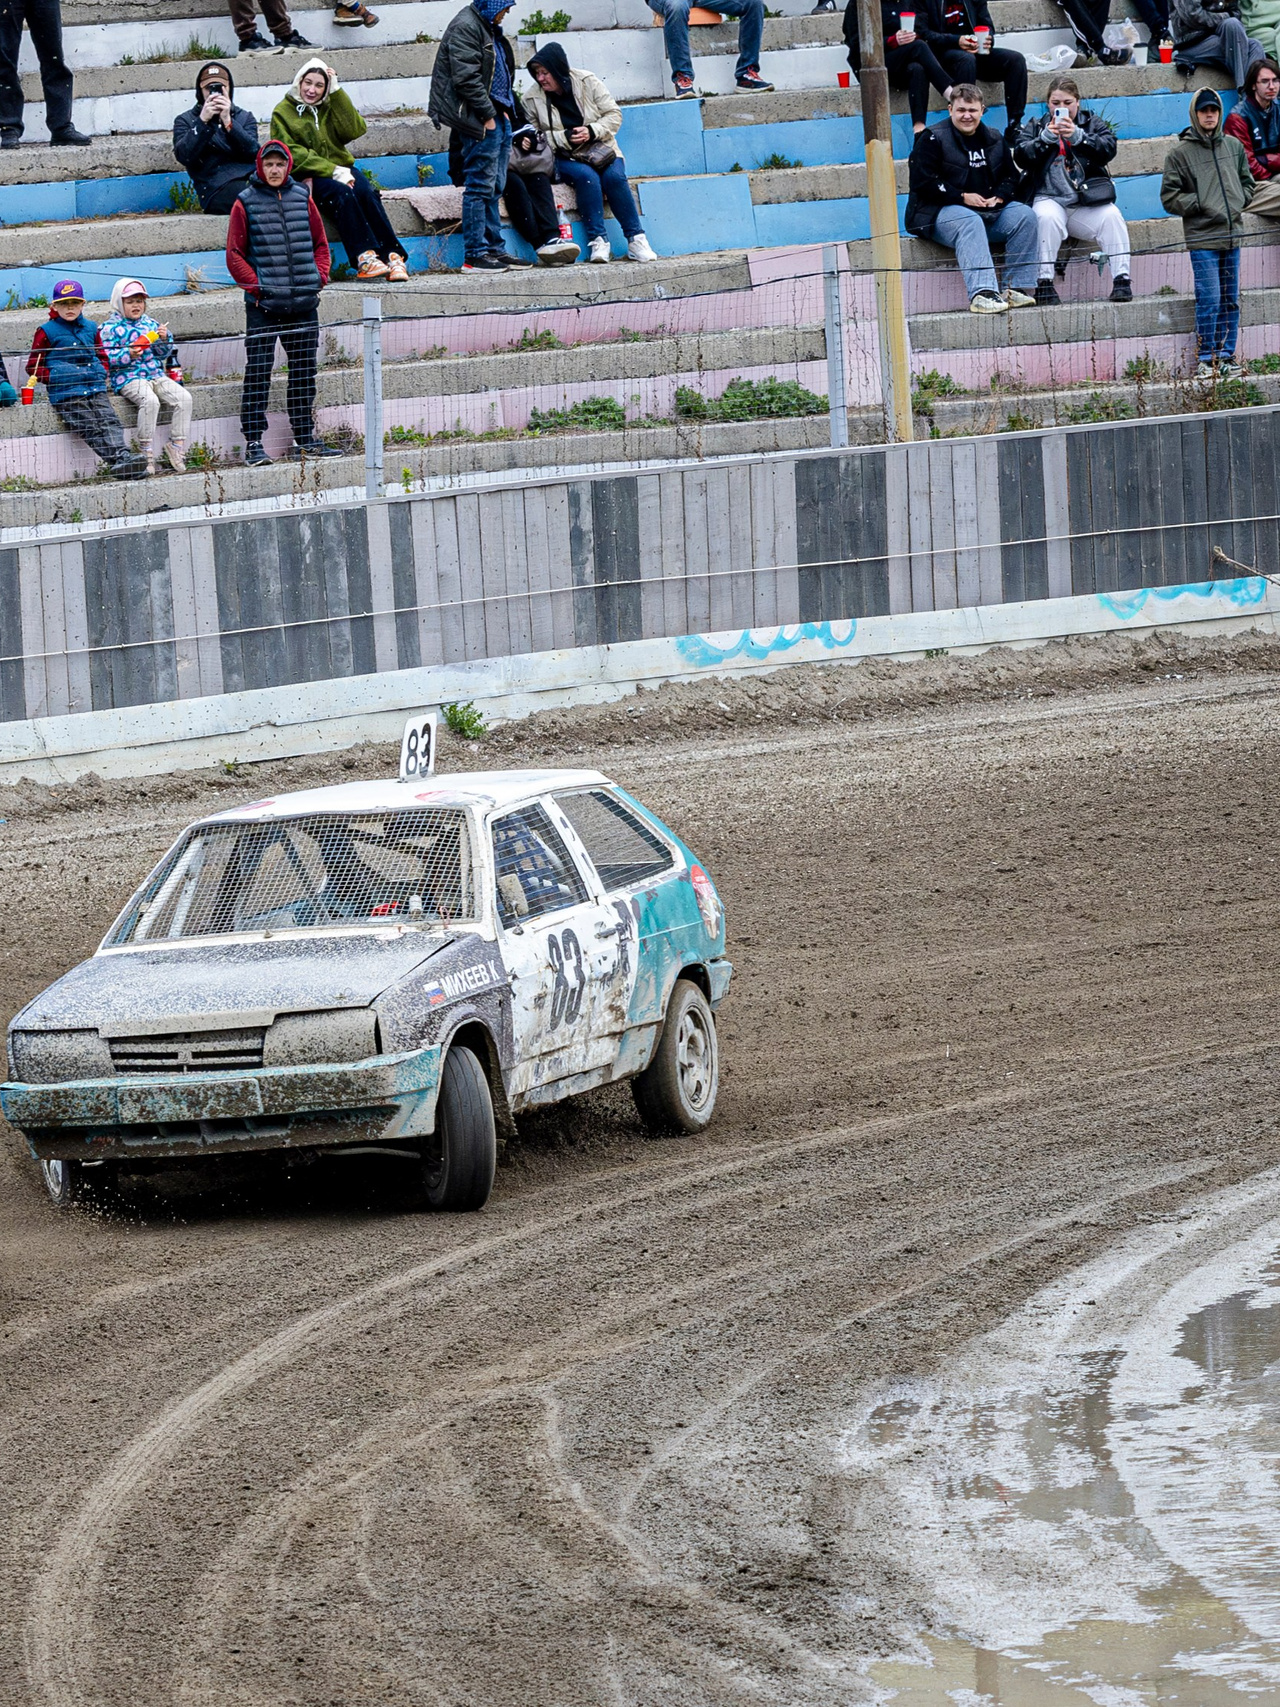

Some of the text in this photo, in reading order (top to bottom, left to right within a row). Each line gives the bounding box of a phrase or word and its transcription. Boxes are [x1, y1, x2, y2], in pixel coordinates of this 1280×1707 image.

[405, 722, 432, 778] 83
[439, 959, 501, 998] МИХЕЕВ К
[547, 928, 587, 1031] 83
